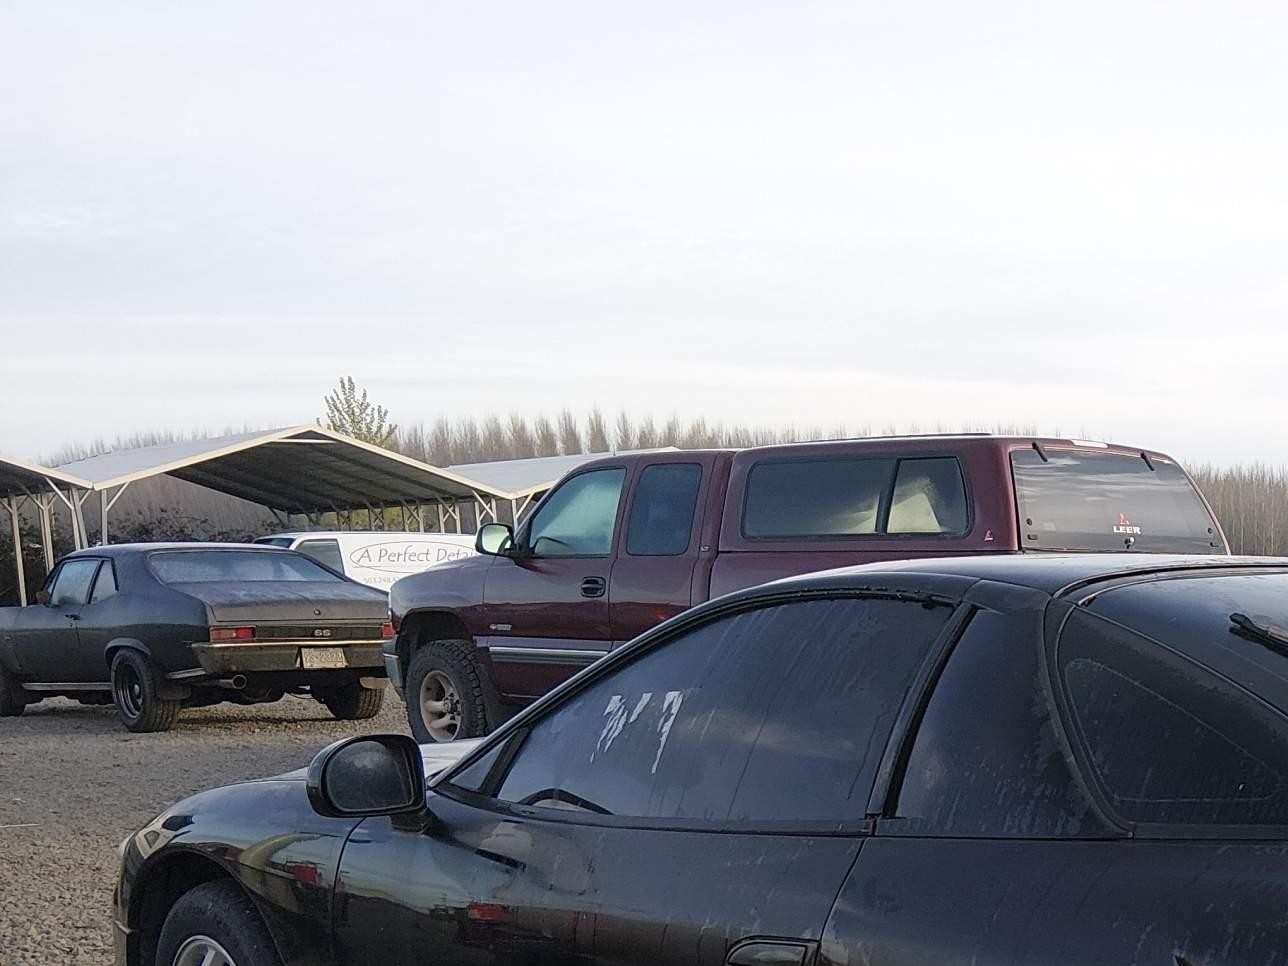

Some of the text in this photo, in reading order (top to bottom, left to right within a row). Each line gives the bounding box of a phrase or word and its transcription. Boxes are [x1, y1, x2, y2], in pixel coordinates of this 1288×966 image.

[1113, 525, 1142, 535] LEER
[358, 548, 372, 562] A
[378, 544, 431, 562] Perfect
[314, 629, 331, 637] SS
